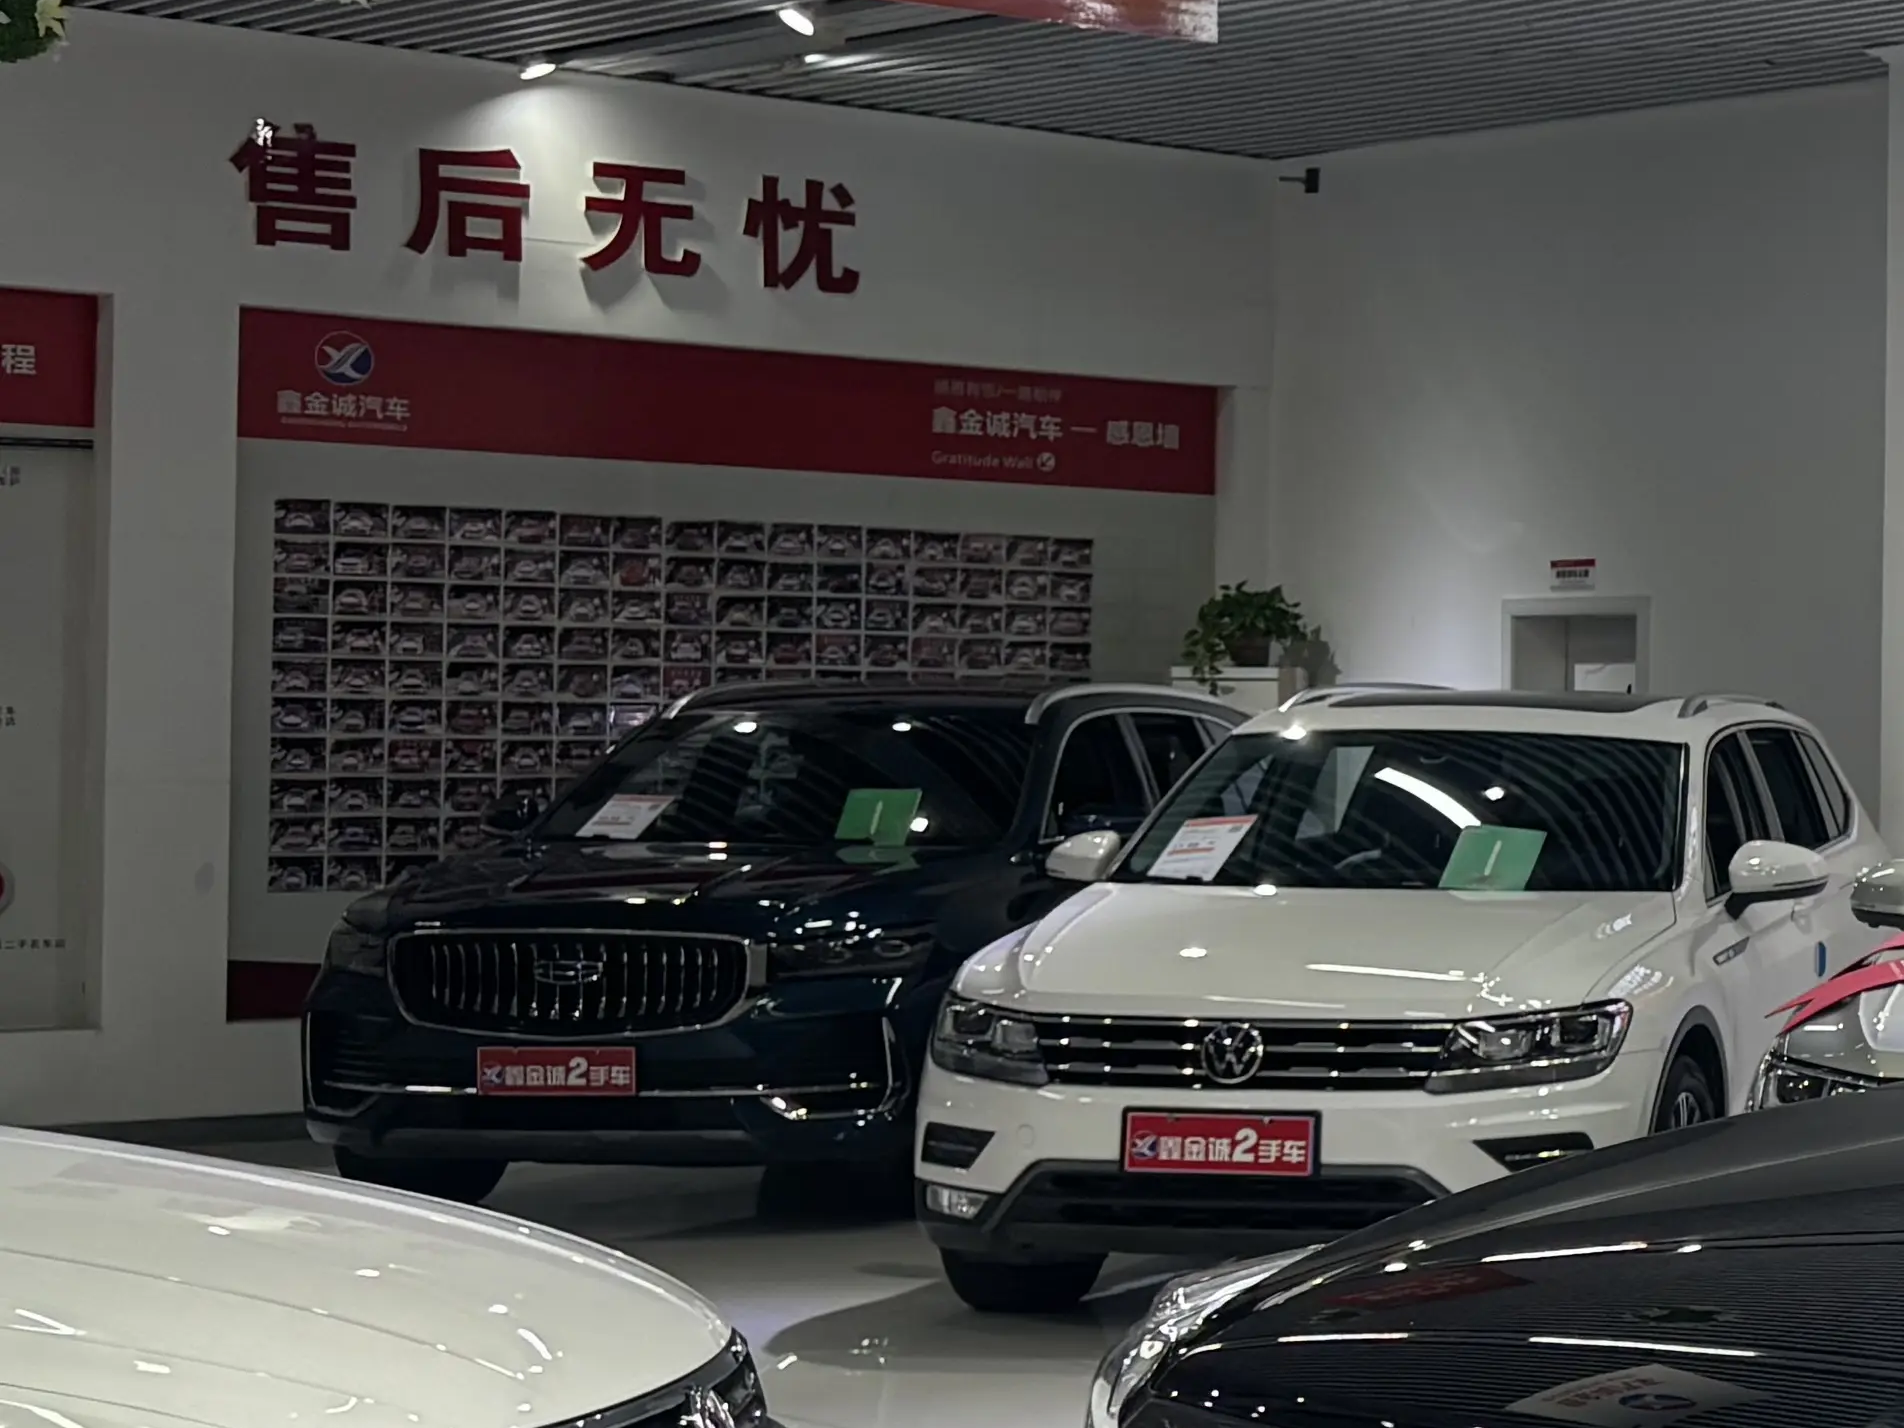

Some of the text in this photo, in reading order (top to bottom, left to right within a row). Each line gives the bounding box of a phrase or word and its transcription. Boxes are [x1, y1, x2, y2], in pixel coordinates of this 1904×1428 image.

[229, 118, 859, 294] 售后无忧
[1158, 1127, 1308, 1164] 鑫金诚2手车
